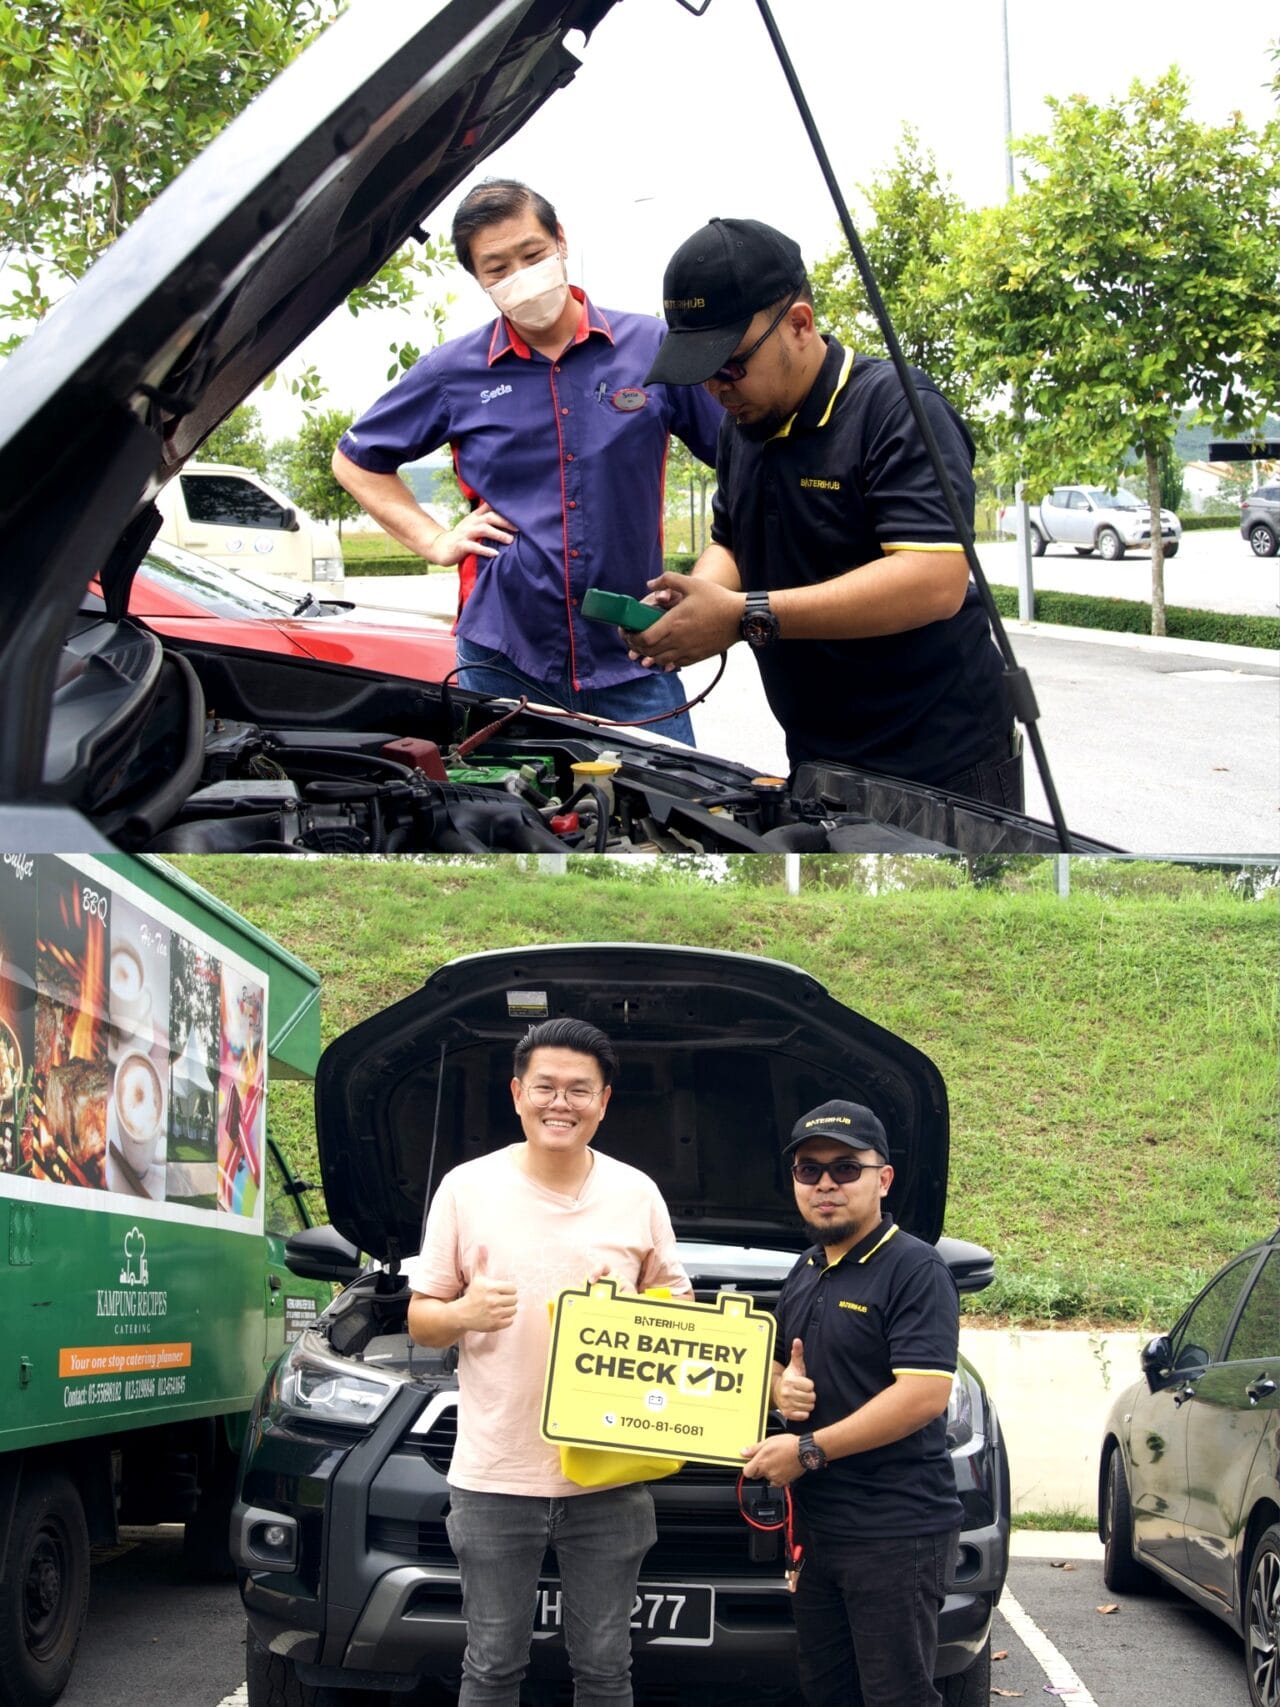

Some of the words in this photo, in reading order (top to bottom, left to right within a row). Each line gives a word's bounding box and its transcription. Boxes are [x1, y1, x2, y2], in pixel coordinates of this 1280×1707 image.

[480, 384, 512, 404] Setia
[82, 887, 108, 928] BBQ
[96, 1289, 137, 1316] KAMPUNG
[137, 1291, 167, 1316] RECIPES
[114, 1323, 151, 1334] CATERING
[634, 1315, 696, 1332] BATERIHUB
[579, 1327, 630, 1349] CAR
[637, 1334, 747, 1364] BATTERY
[71, 1353, 90, 1370] Your
[91, 1356, 108, 1368] one
[108, 1353, 125, 1371] stop
[126, 1350, 156, 1367] catering
[155, 1349, 184, 1367] planner
[575, 1353, 677, 1386] CHECK
[63, 1385, 87, 1408] Contact:
[620, 1416, 704, 1437] 1700-81-6081
